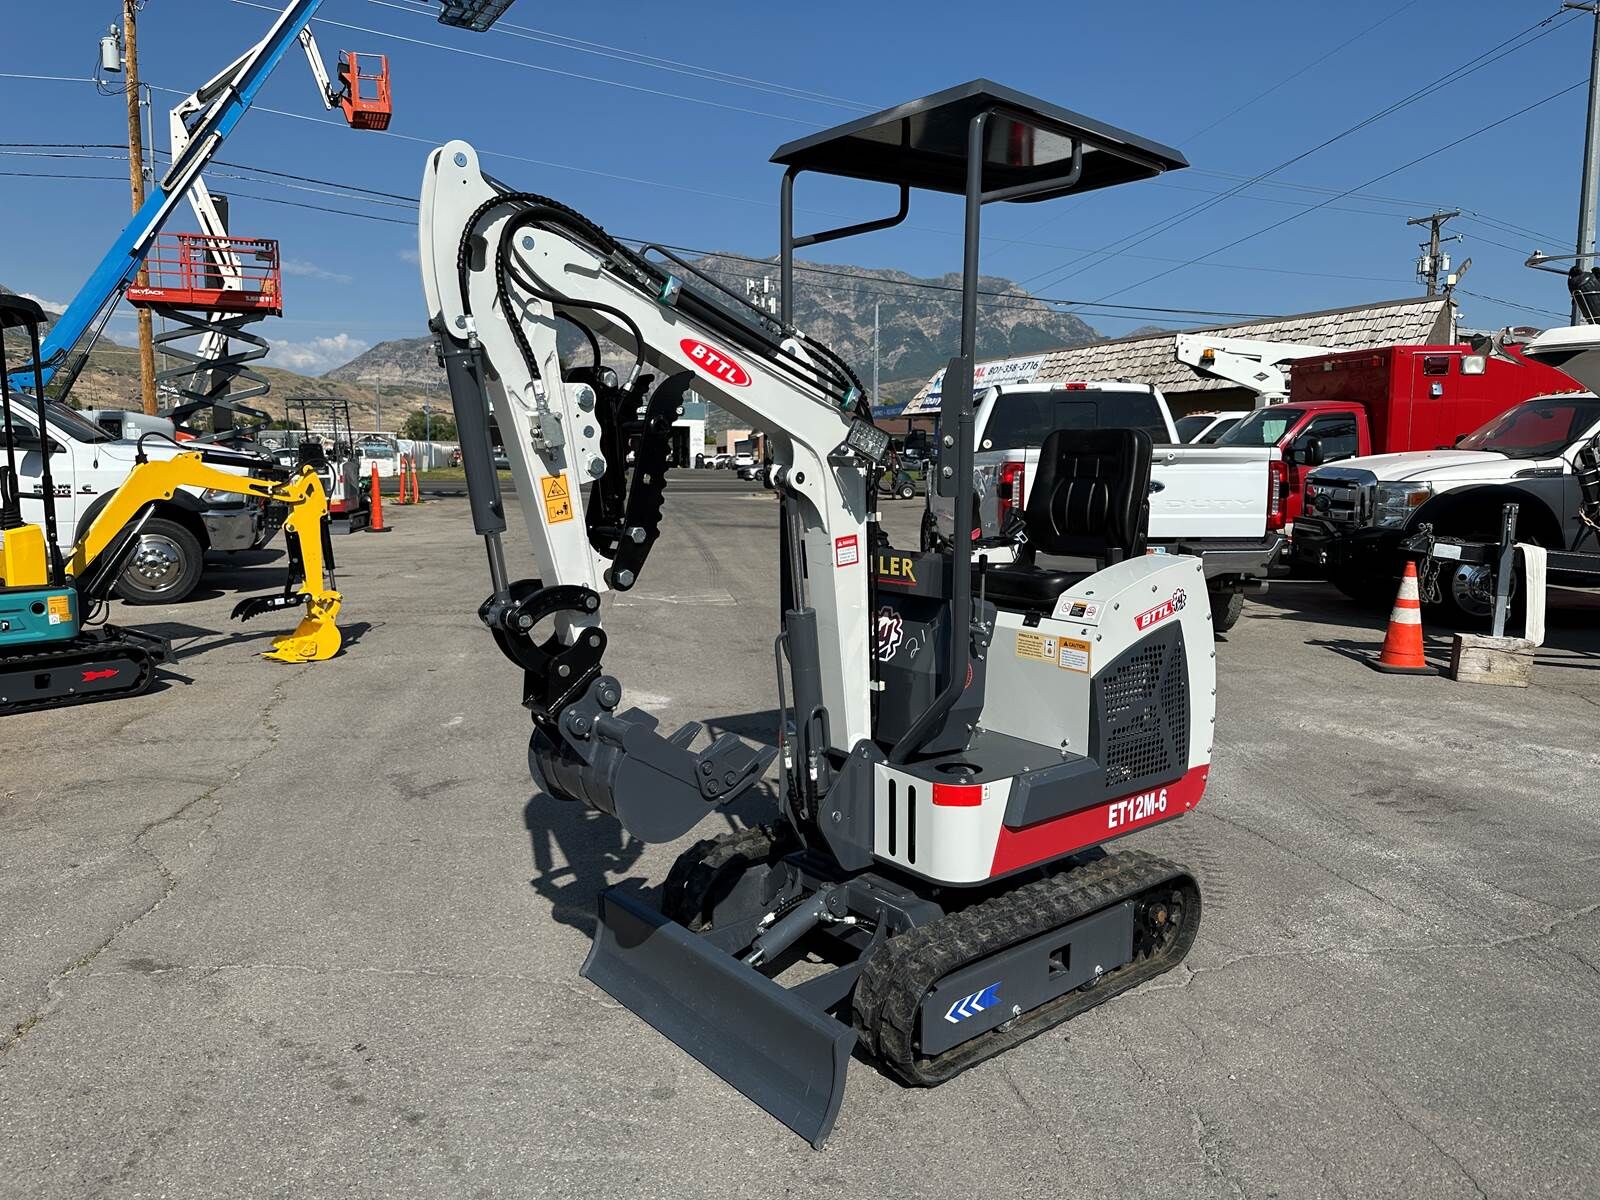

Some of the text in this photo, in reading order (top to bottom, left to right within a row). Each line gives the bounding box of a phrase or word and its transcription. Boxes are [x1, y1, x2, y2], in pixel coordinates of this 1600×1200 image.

[690, 344, 737, 383] BTTL
[987, 360, 1040, 376] 801-358-3716
[1141, 602, 1172, 628] BTTL
[1108, 788, 1168, 829] ET12M-6
